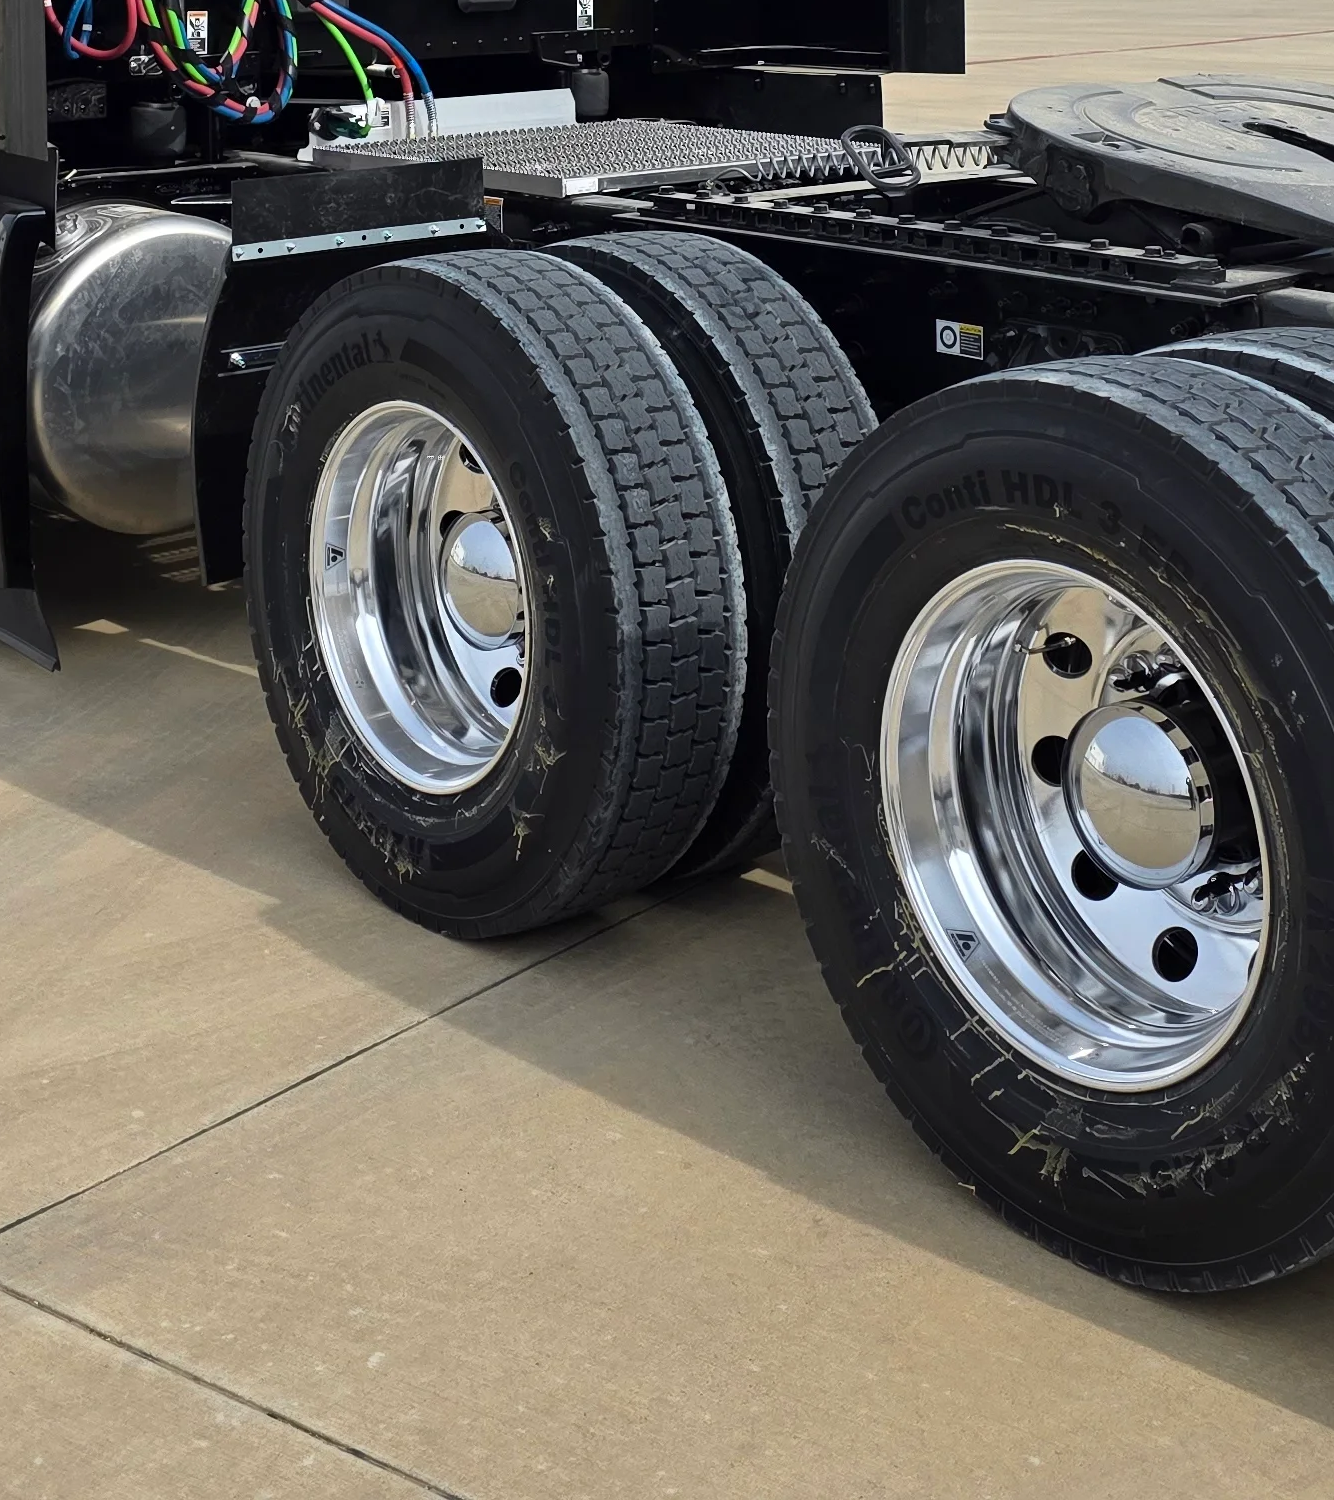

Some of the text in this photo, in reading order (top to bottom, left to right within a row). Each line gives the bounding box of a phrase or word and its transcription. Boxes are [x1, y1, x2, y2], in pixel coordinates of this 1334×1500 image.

[900, 469, 992, 531] Conti
[1000, 468, 1083, 520] HDL
[1097, 500, 1124, 535] 3
